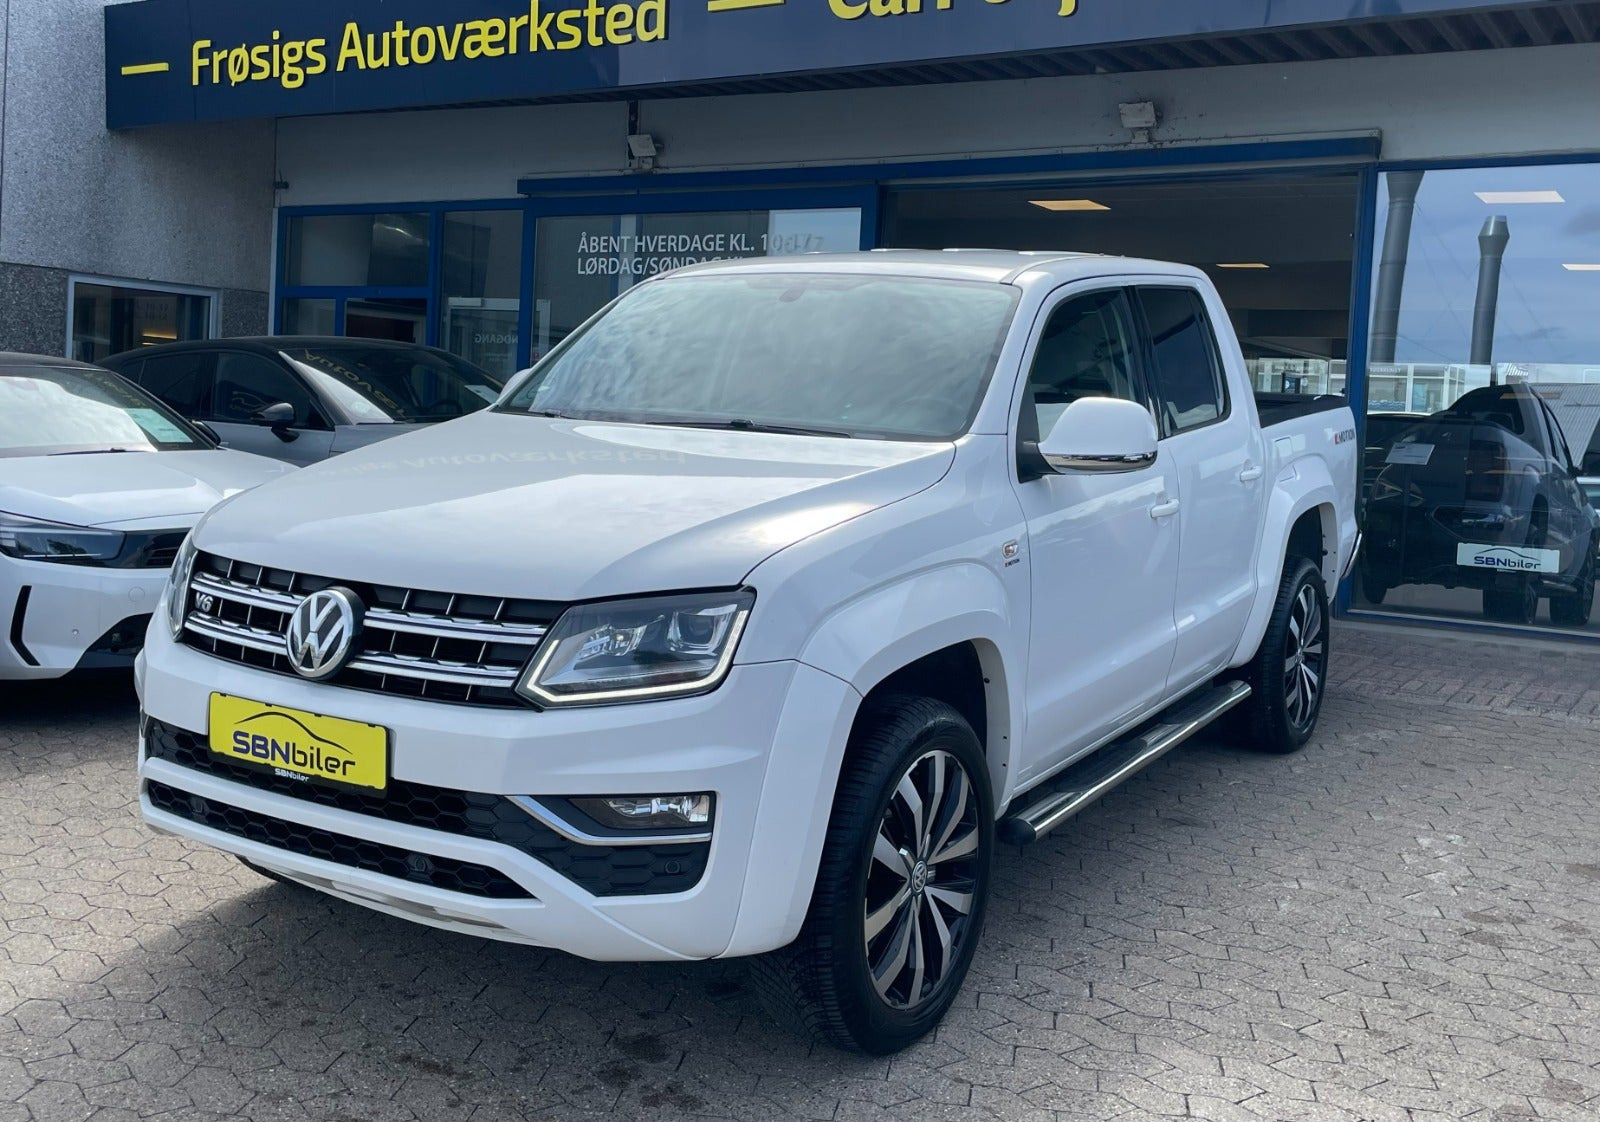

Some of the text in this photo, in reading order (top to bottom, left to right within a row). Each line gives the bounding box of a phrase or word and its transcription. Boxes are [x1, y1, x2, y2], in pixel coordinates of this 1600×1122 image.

[191, 0, 667, 89] Frøsigs Autoværksted
[577, 232, 631, 253] ÅBENT
[635, 234, 724, 252] HVERDAGE
[730, 233, 755, 251] KL.
[577, 256, 722, 276] LØRDAG/SØN
[1474, 556, 1542, 570] SBNbiler
[195, 592, 214, 612] V6
[232, 730, 356, 776] SBNbiler
[274, 768, 310, 782] SBNbiler
